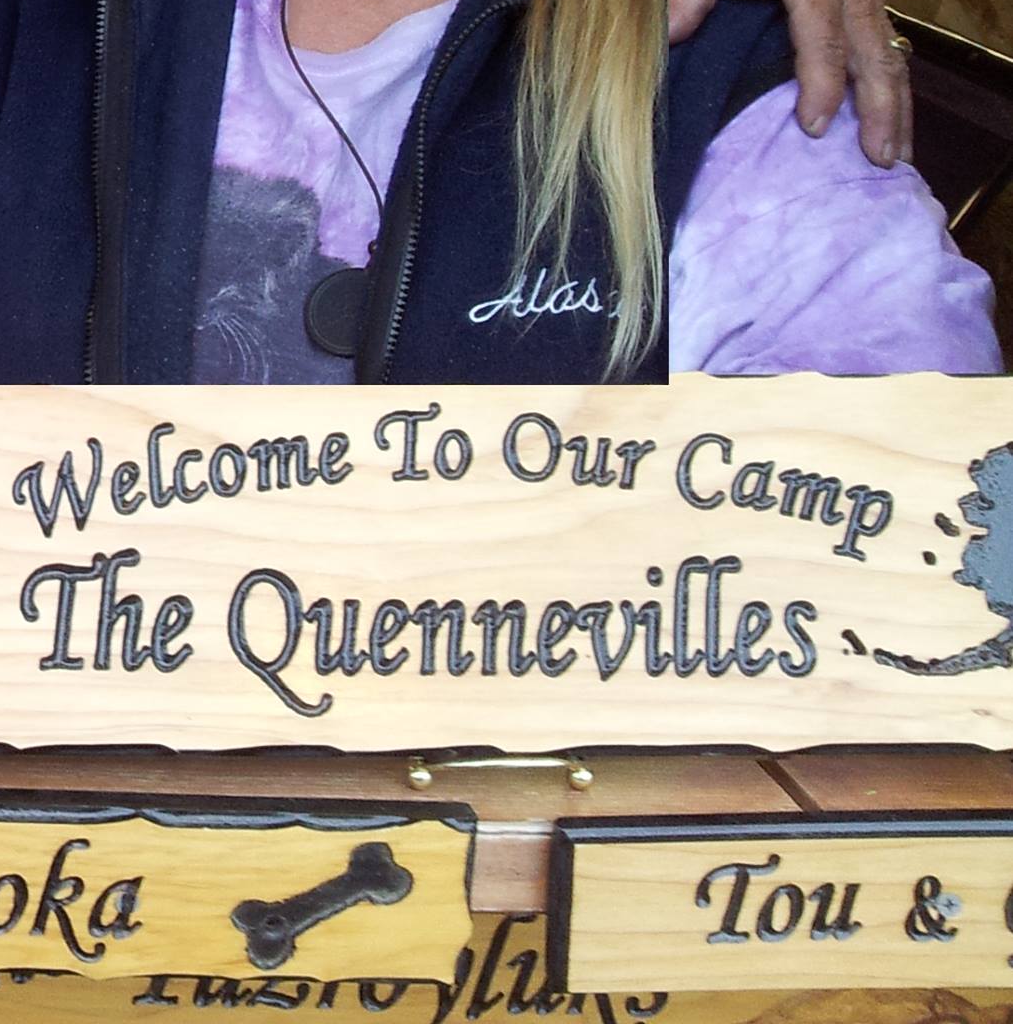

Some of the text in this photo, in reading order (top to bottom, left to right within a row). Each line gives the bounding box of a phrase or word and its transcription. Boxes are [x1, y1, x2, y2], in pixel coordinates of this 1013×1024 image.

[469, 267, 623, 323] Alas
[12, 402, 893, 562] Welcome To Our Camp
[20, 547, 817, 717] The Quennevilles
[696, 853, 862, 944] Tou
[905, 874, 959, 943] &
